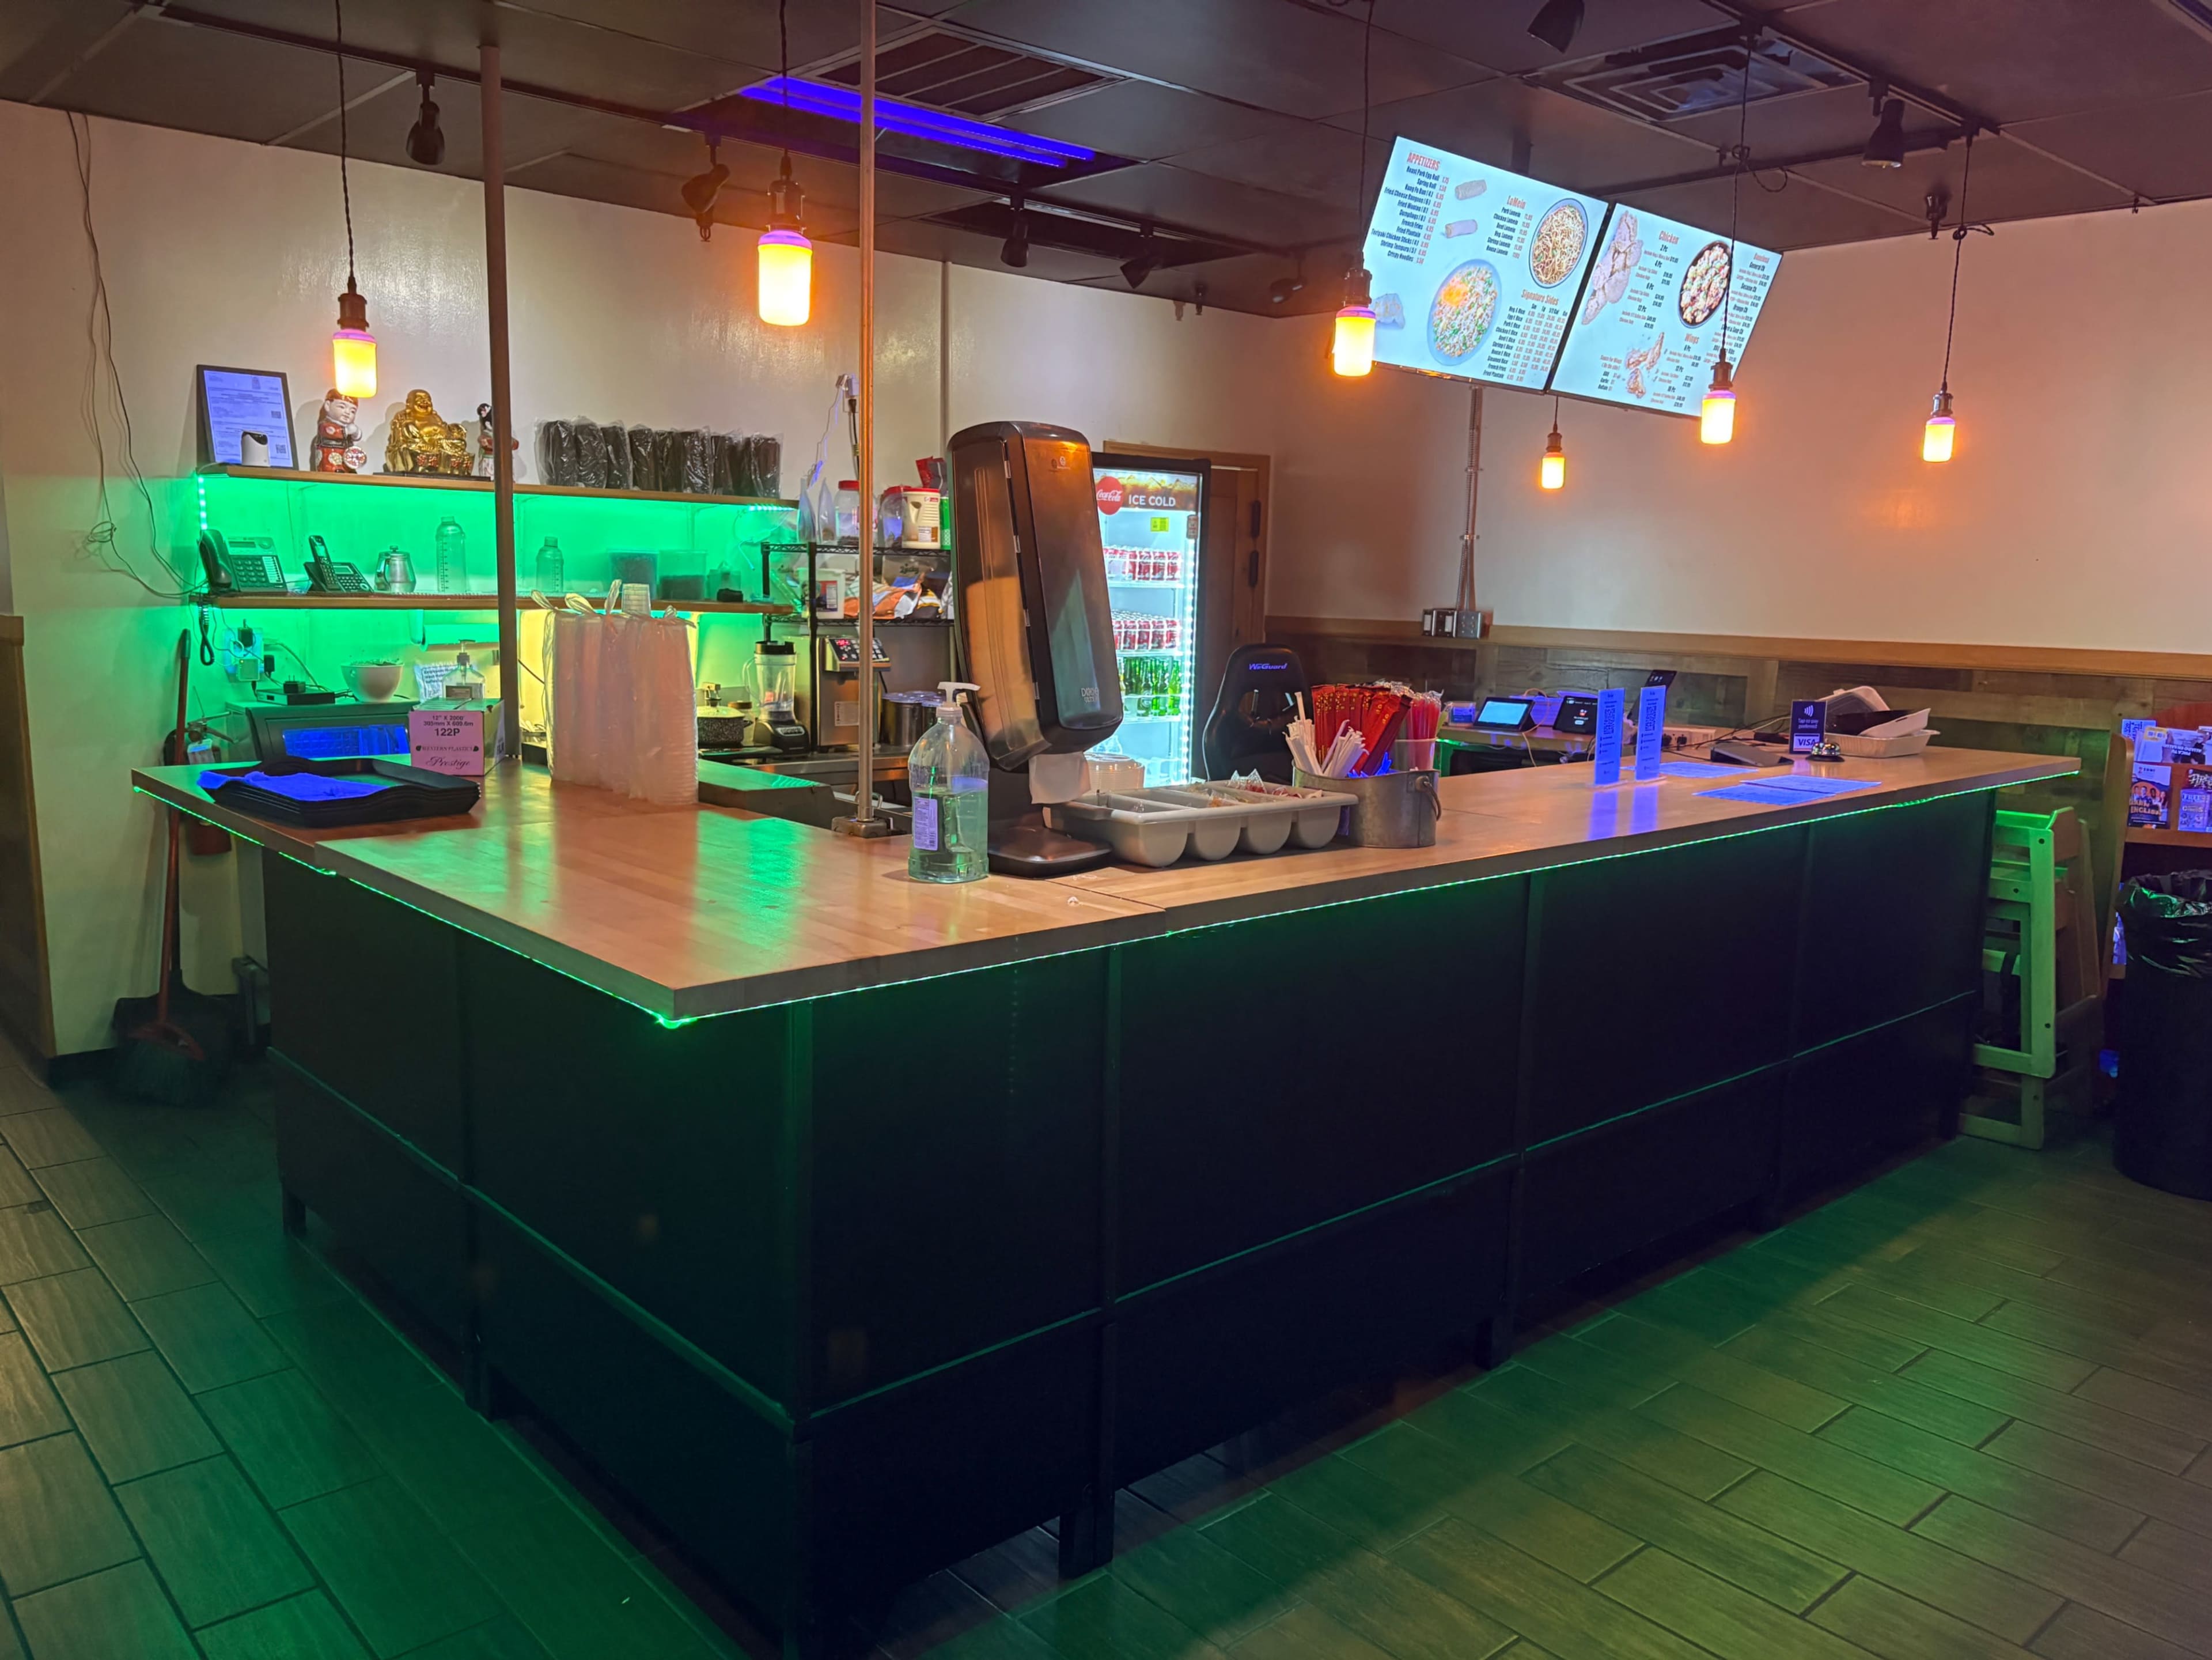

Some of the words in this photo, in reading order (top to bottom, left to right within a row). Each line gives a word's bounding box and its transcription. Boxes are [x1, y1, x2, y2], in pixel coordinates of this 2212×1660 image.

[1407, 152, 1440, 170] APPETIZERS
[1406, 166, 1417, 174] Roast
[1416, 179, 1429, 187] Spring
[1394, 190, 1407, 198] Cheese
[1408, 194, 1423, 203] Rangoon
[1399, 210, 1418, 219] Dumplings
[1371, 229, 1385, 237] Teriyaki
[1386, 232, 1400, 241] Chicken
[1406, 229, 1421, 237] Plantain
[1658, 230, 1679, 244] Chicken
[1393, 243, 1409, 251] Tempura
[1749, 262, 1761, 270] General
[1521, 289, 1546, 302] Signature
[1544, 294, 1559, 305] Sides
[1684, 333, 1699, 344] Wings
[1096, 489, 1123, 502] Coca-Cola
[1128, 494, 1146, 505] ICE
[1149, 496, 1176, 507] COLD
[434, 728, 460, 736] 122P
[426, 756, 471, 770] Prestige
